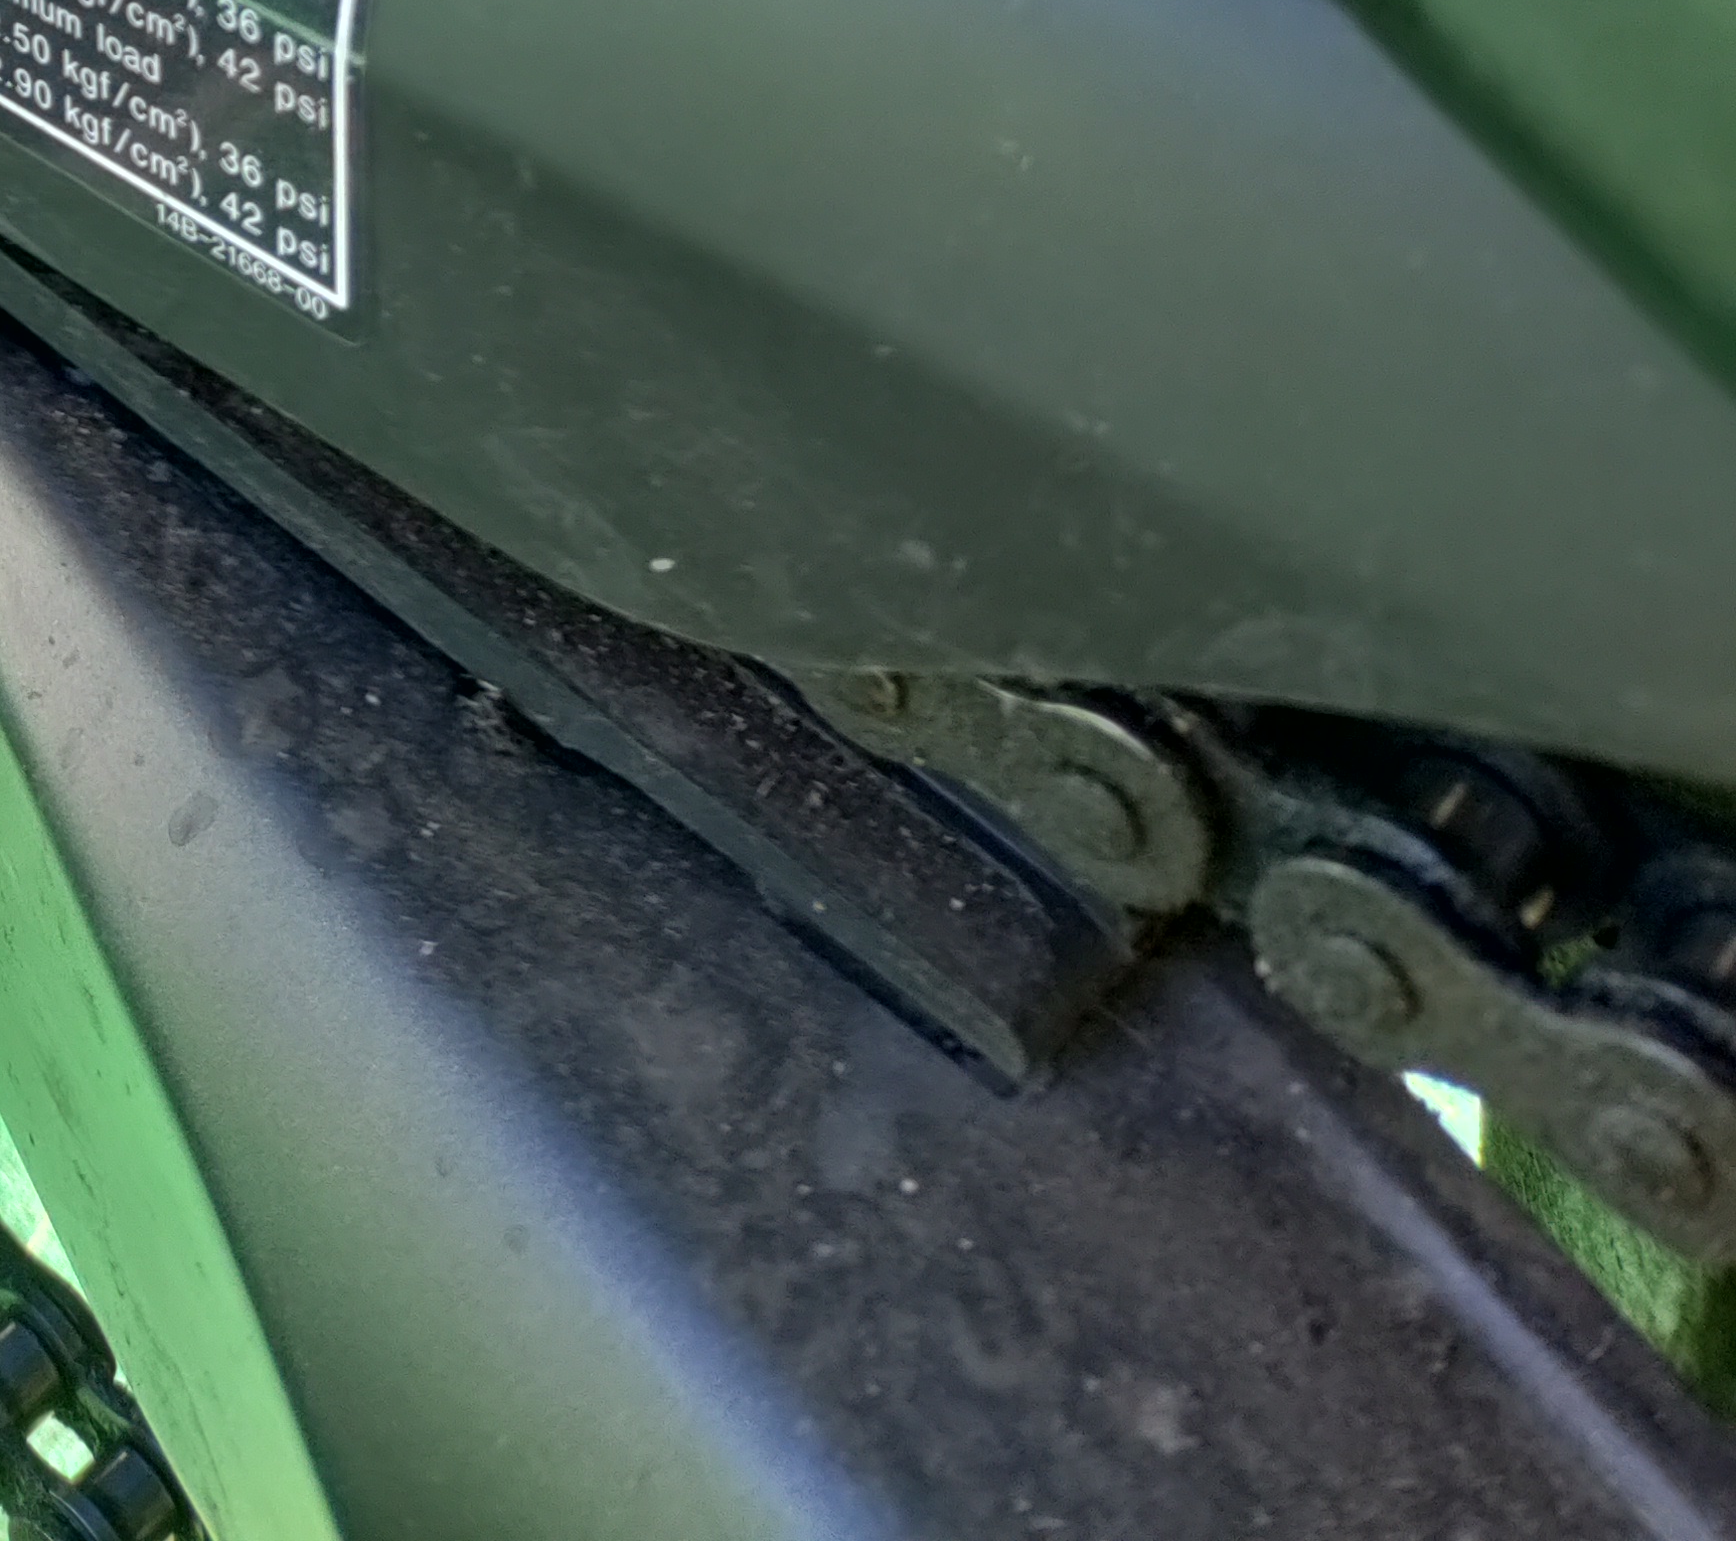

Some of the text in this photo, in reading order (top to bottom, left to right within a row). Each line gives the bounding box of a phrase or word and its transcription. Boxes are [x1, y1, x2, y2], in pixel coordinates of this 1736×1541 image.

[96, 23, 162, 84] load
[217, 48, 262, 94] 42
[274, 81, 329, 131] psi
[273, 31, 329, 82] psi
[219, 141, 263, 188] 36
[275, 178, 330, 228] psi
[155, 203, 328, 320] 14B-21668-00
[220, 191, 263, 237] 42
[276, 226, 330, 275] psi
